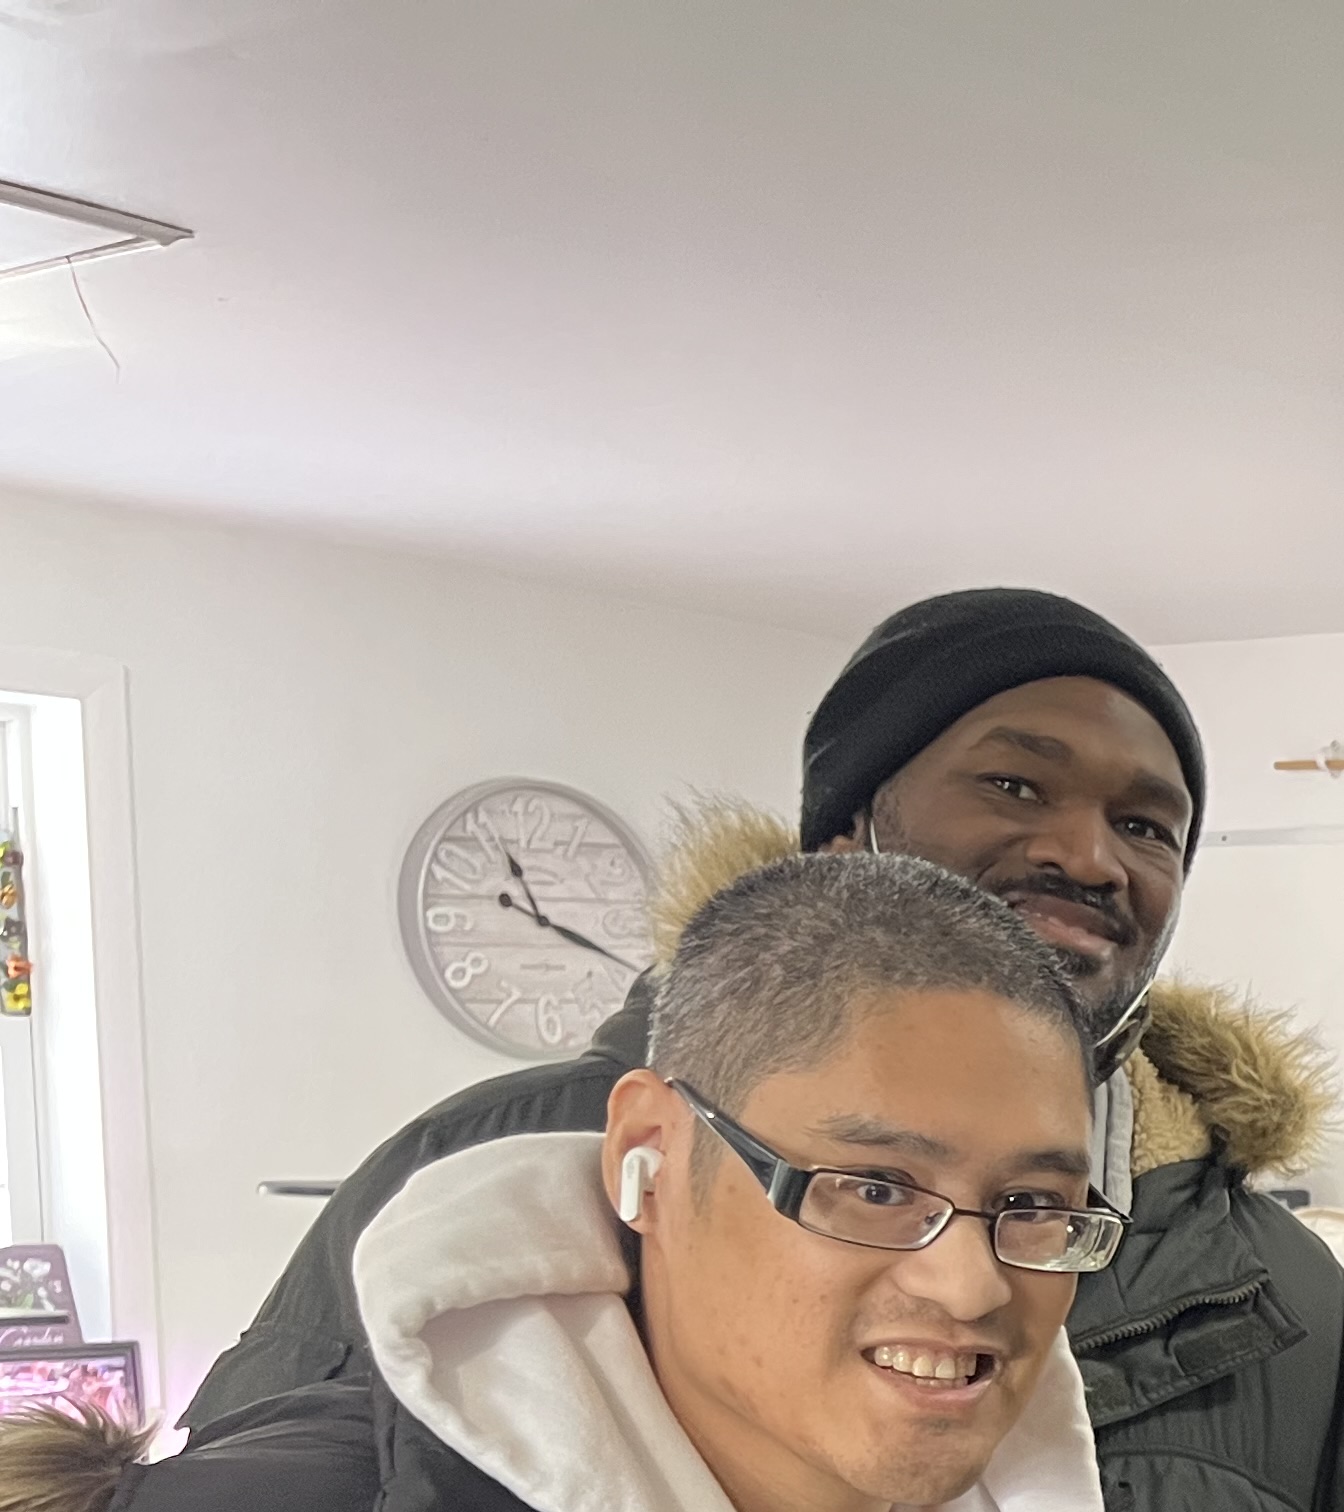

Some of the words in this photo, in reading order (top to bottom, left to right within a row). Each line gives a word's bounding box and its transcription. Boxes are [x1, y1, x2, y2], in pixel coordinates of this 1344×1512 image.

[512, 796, 555, 851] 12
[432, 841, 486, 892] 10
[425, 906, 474, 933] 9
[444, 951, 490, 990] 8
[486, 979, 524, 1029] 7
[535, 993, 563, 1045] 6
